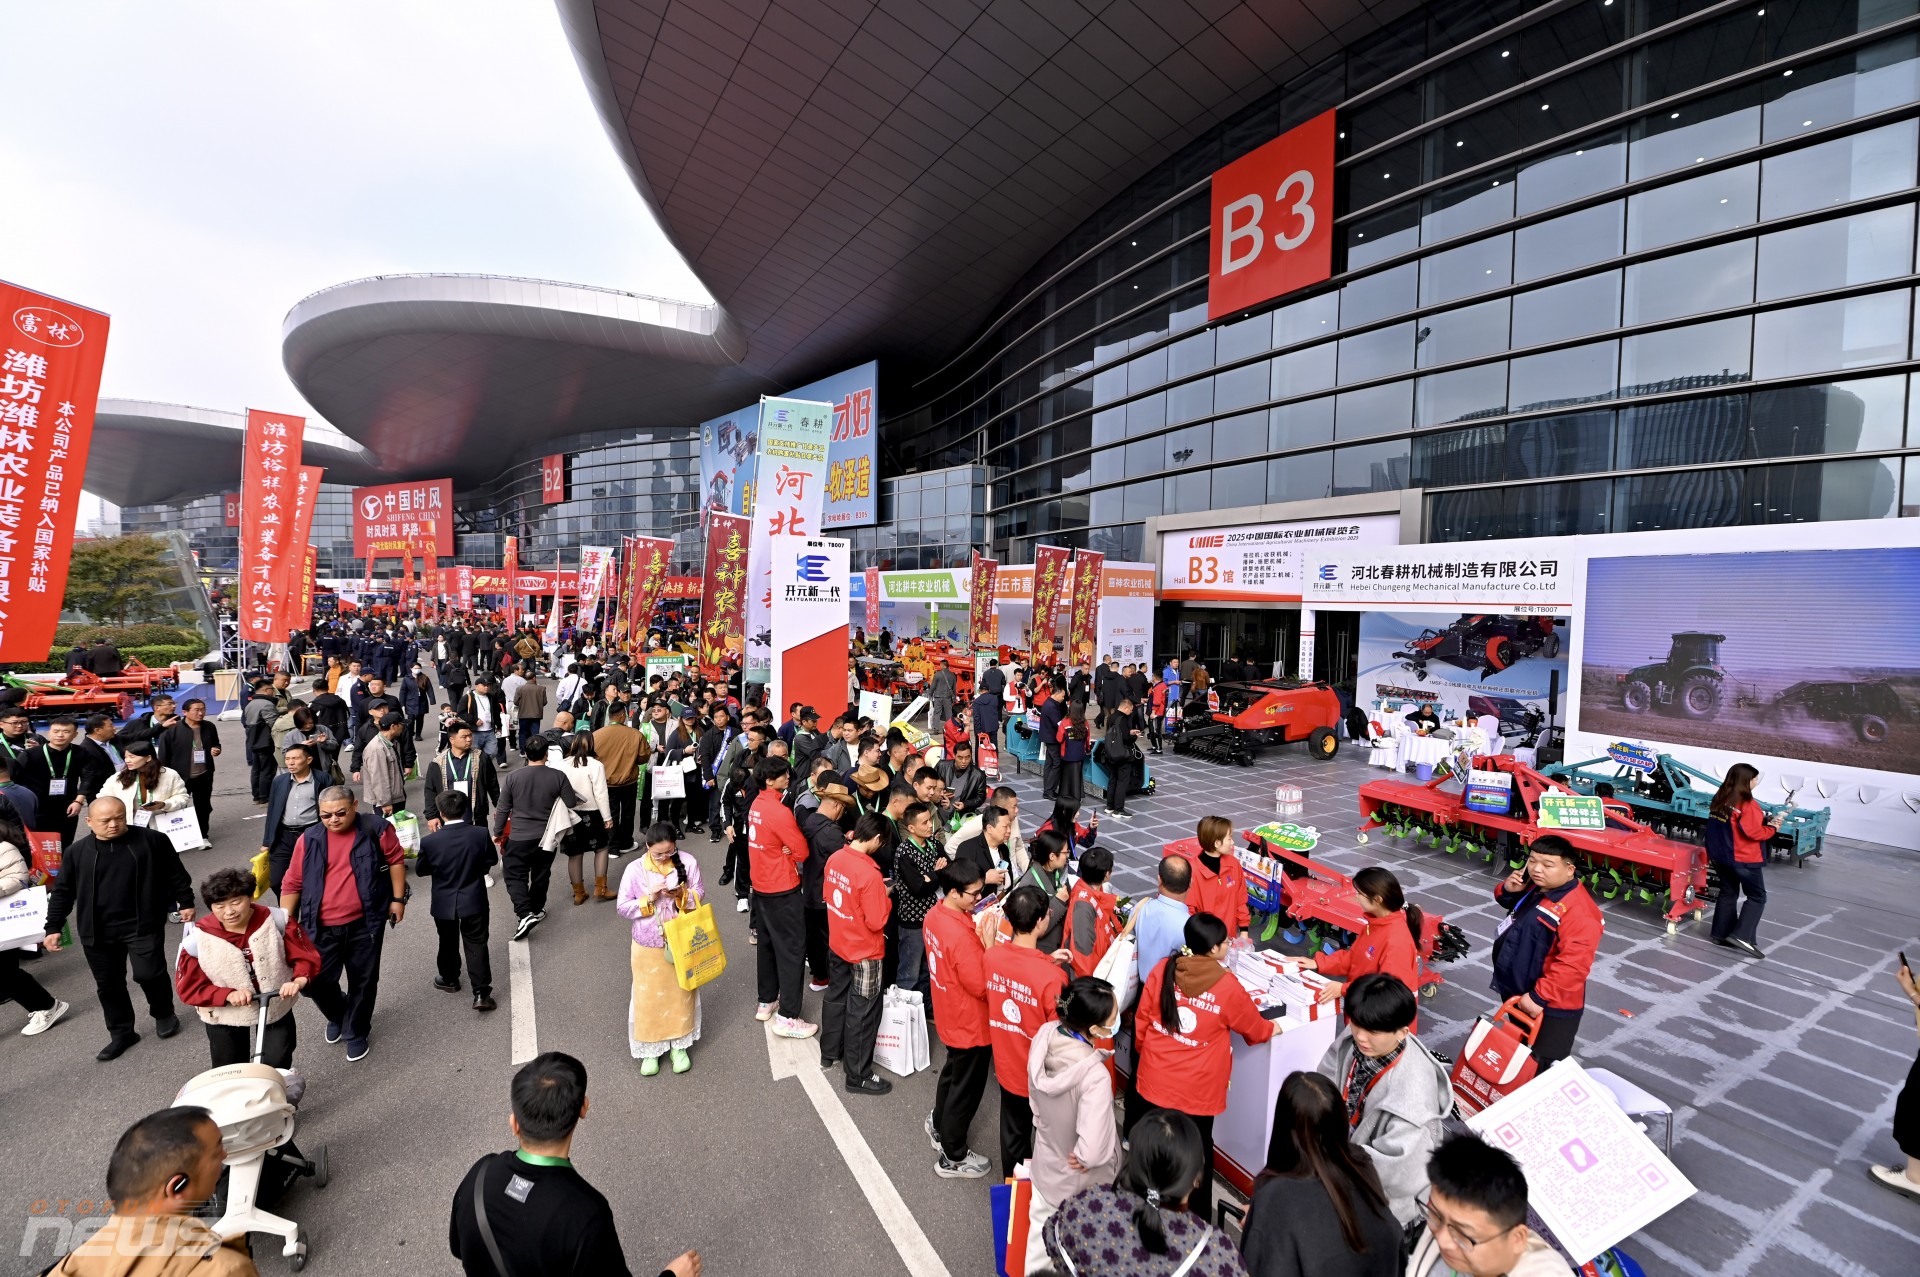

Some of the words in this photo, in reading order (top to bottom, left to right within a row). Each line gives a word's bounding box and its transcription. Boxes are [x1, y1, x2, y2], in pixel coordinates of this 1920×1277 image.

[1221, 169, 1315, 276] B3
[829, 388, 873, 442] 才好
[544, 465, 561, 492] B2
[824, 455, 871, 503] 牧泽造
[28, 400, 76, 593] 本公司产品已纳入国家补贴
[384, 487, 442, 513] 中国时风
[386, 512, 415, 522] SHIFENG
[366, 524, 398, 538] 时风时风
[1227, 525, 1361, 542] 2025中国国际农业机械展览会
[1188, 556, 1218, 584] B3
[1222, 569, 1234, 583] 馆
[1351, 560, 1558, 580] 河北春耕机械制造有限公司
[459, 568, 472, 611] 东科重工
[517, 578, 546, 588] LWNZ
[706, 529, 748, 638] 喜神农机
[785, 585, 841, 598] 开元新一代
[888, 578, 951, 594] 河北耕牛农业机械
[1350, 583, 1371, 591] Hebei
[1372, 583, 1411, 592] Chungeng
[1412, 582, 1460, 591] Mechanical
[1461, 582, 1520, 591] Manufacture
[1522, 582, 1556, 591] Co.Ltd
[1544, 798, 1597, 808] 开元新一代
